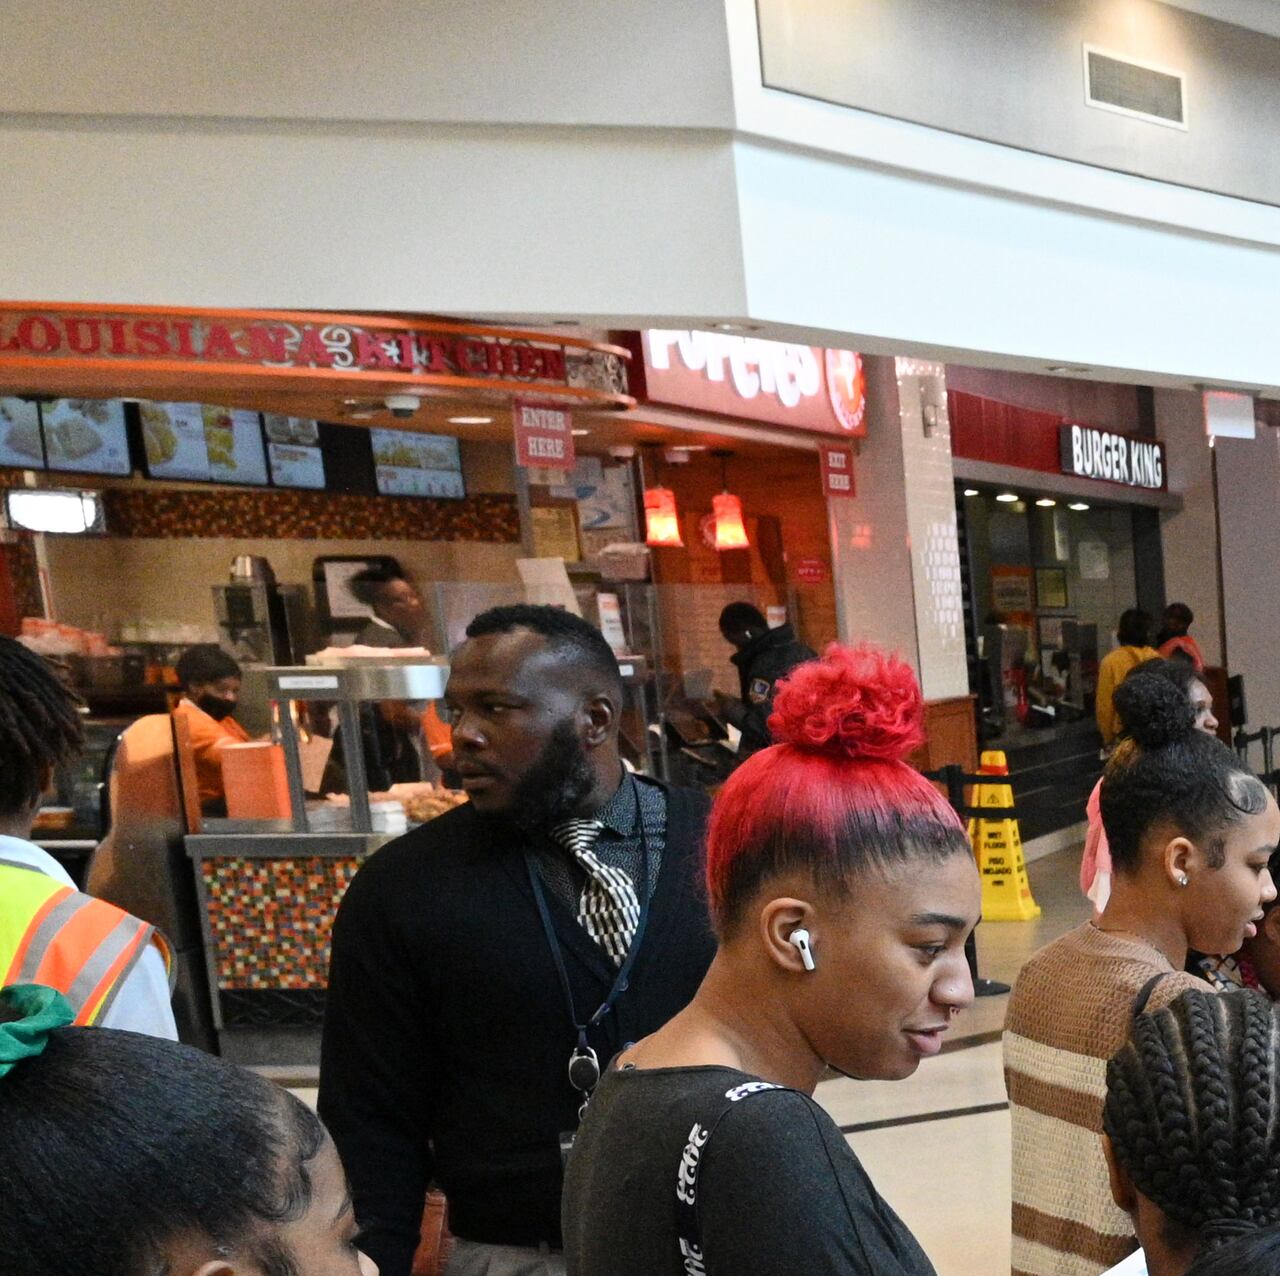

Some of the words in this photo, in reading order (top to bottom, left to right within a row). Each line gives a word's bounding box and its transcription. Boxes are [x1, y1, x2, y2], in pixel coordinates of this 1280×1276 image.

[0, 316, 338, 363] OUISIANA
[521, 406, 566, 431] ENTER
[527, 437, 565, 459] HERE
[1072, 425, 1129, 483] BURGER
[1131, 440, 1162, 489] KING
